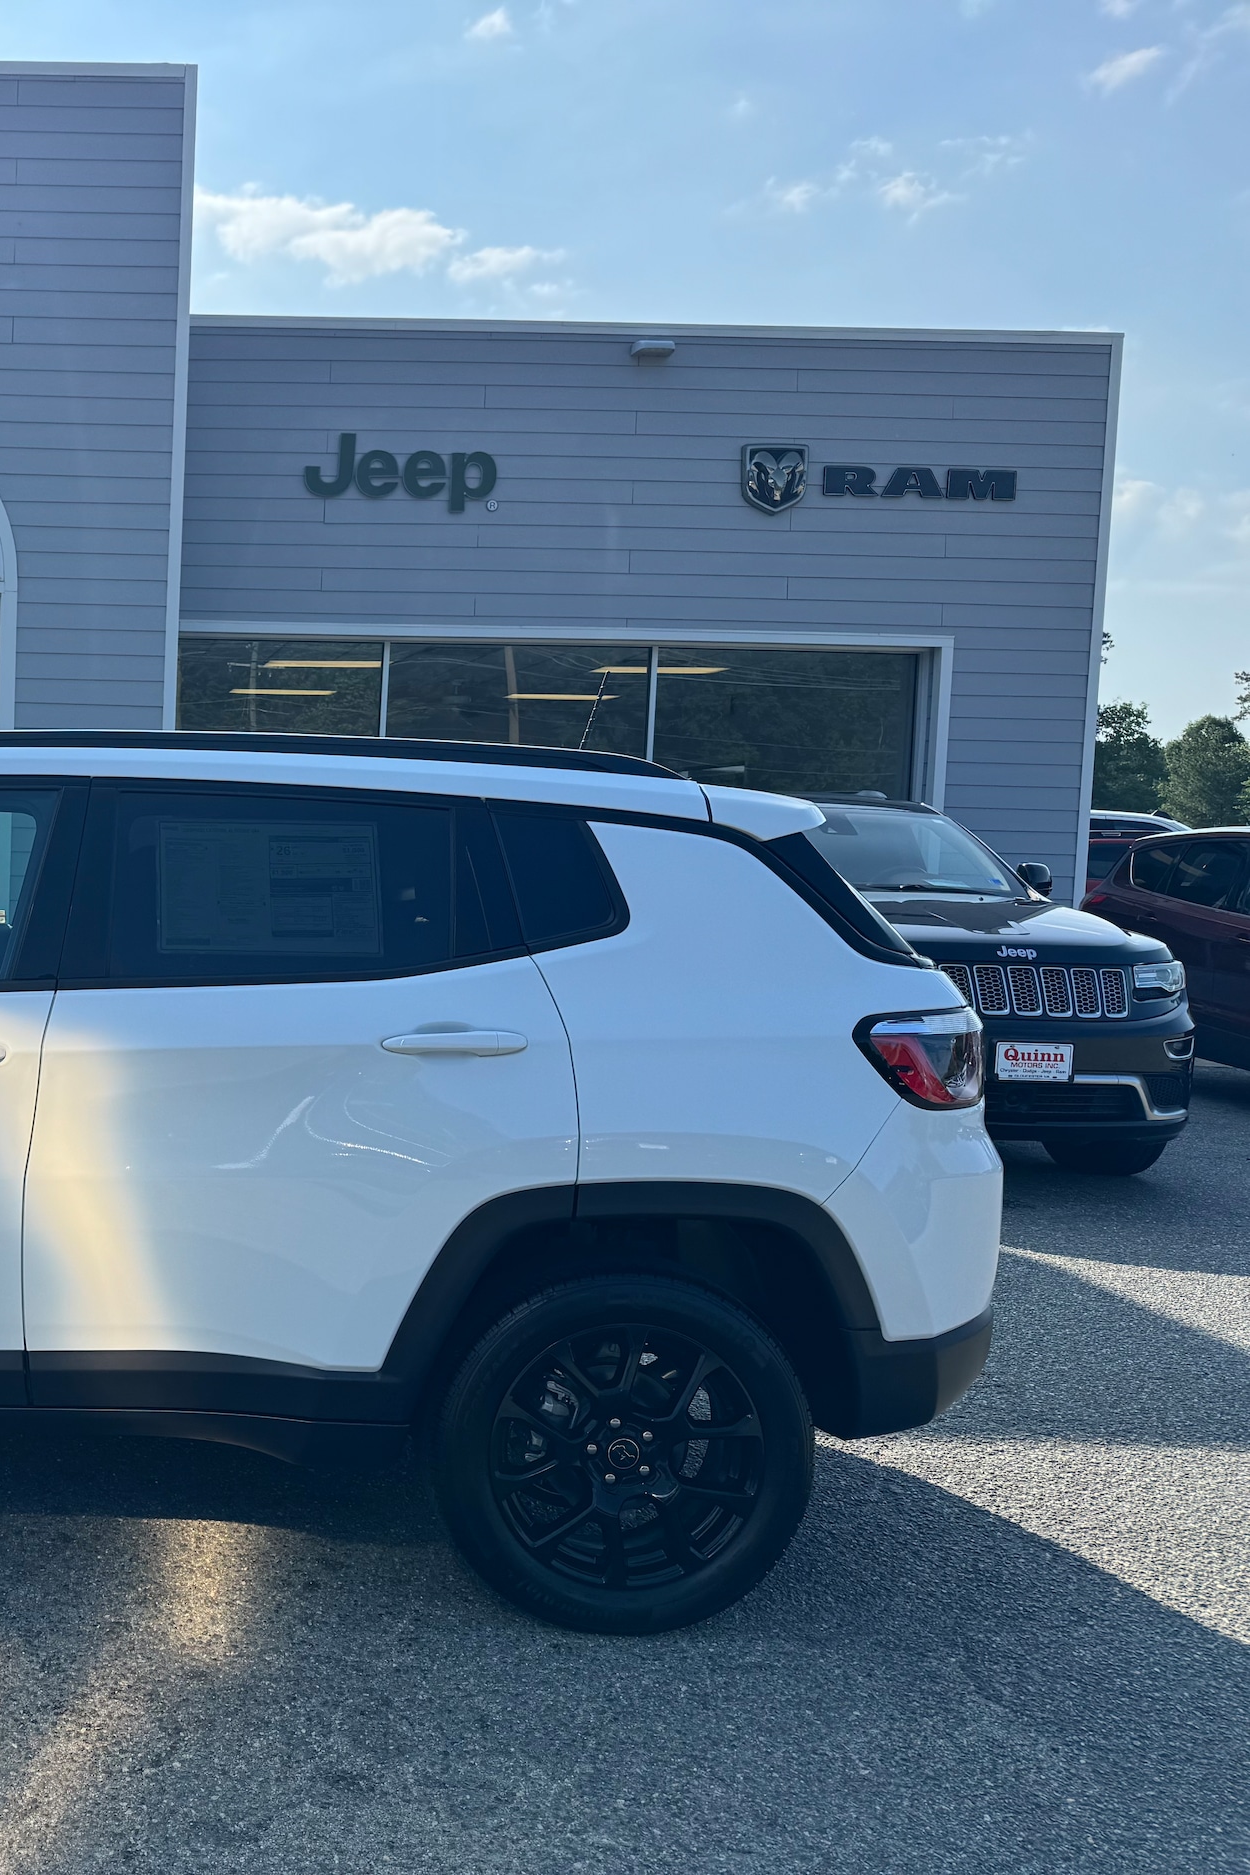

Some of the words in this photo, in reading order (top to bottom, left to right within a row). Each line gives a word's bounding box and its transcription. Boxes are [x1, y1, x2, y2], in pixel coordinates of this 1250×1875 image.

[303, 432, 498, 514] Jeep
[822, 464, 1018, 501] RAM
[996, 945, 1037, 960] Jeep
[1004, 1047, 1065, 1062] Quinn
